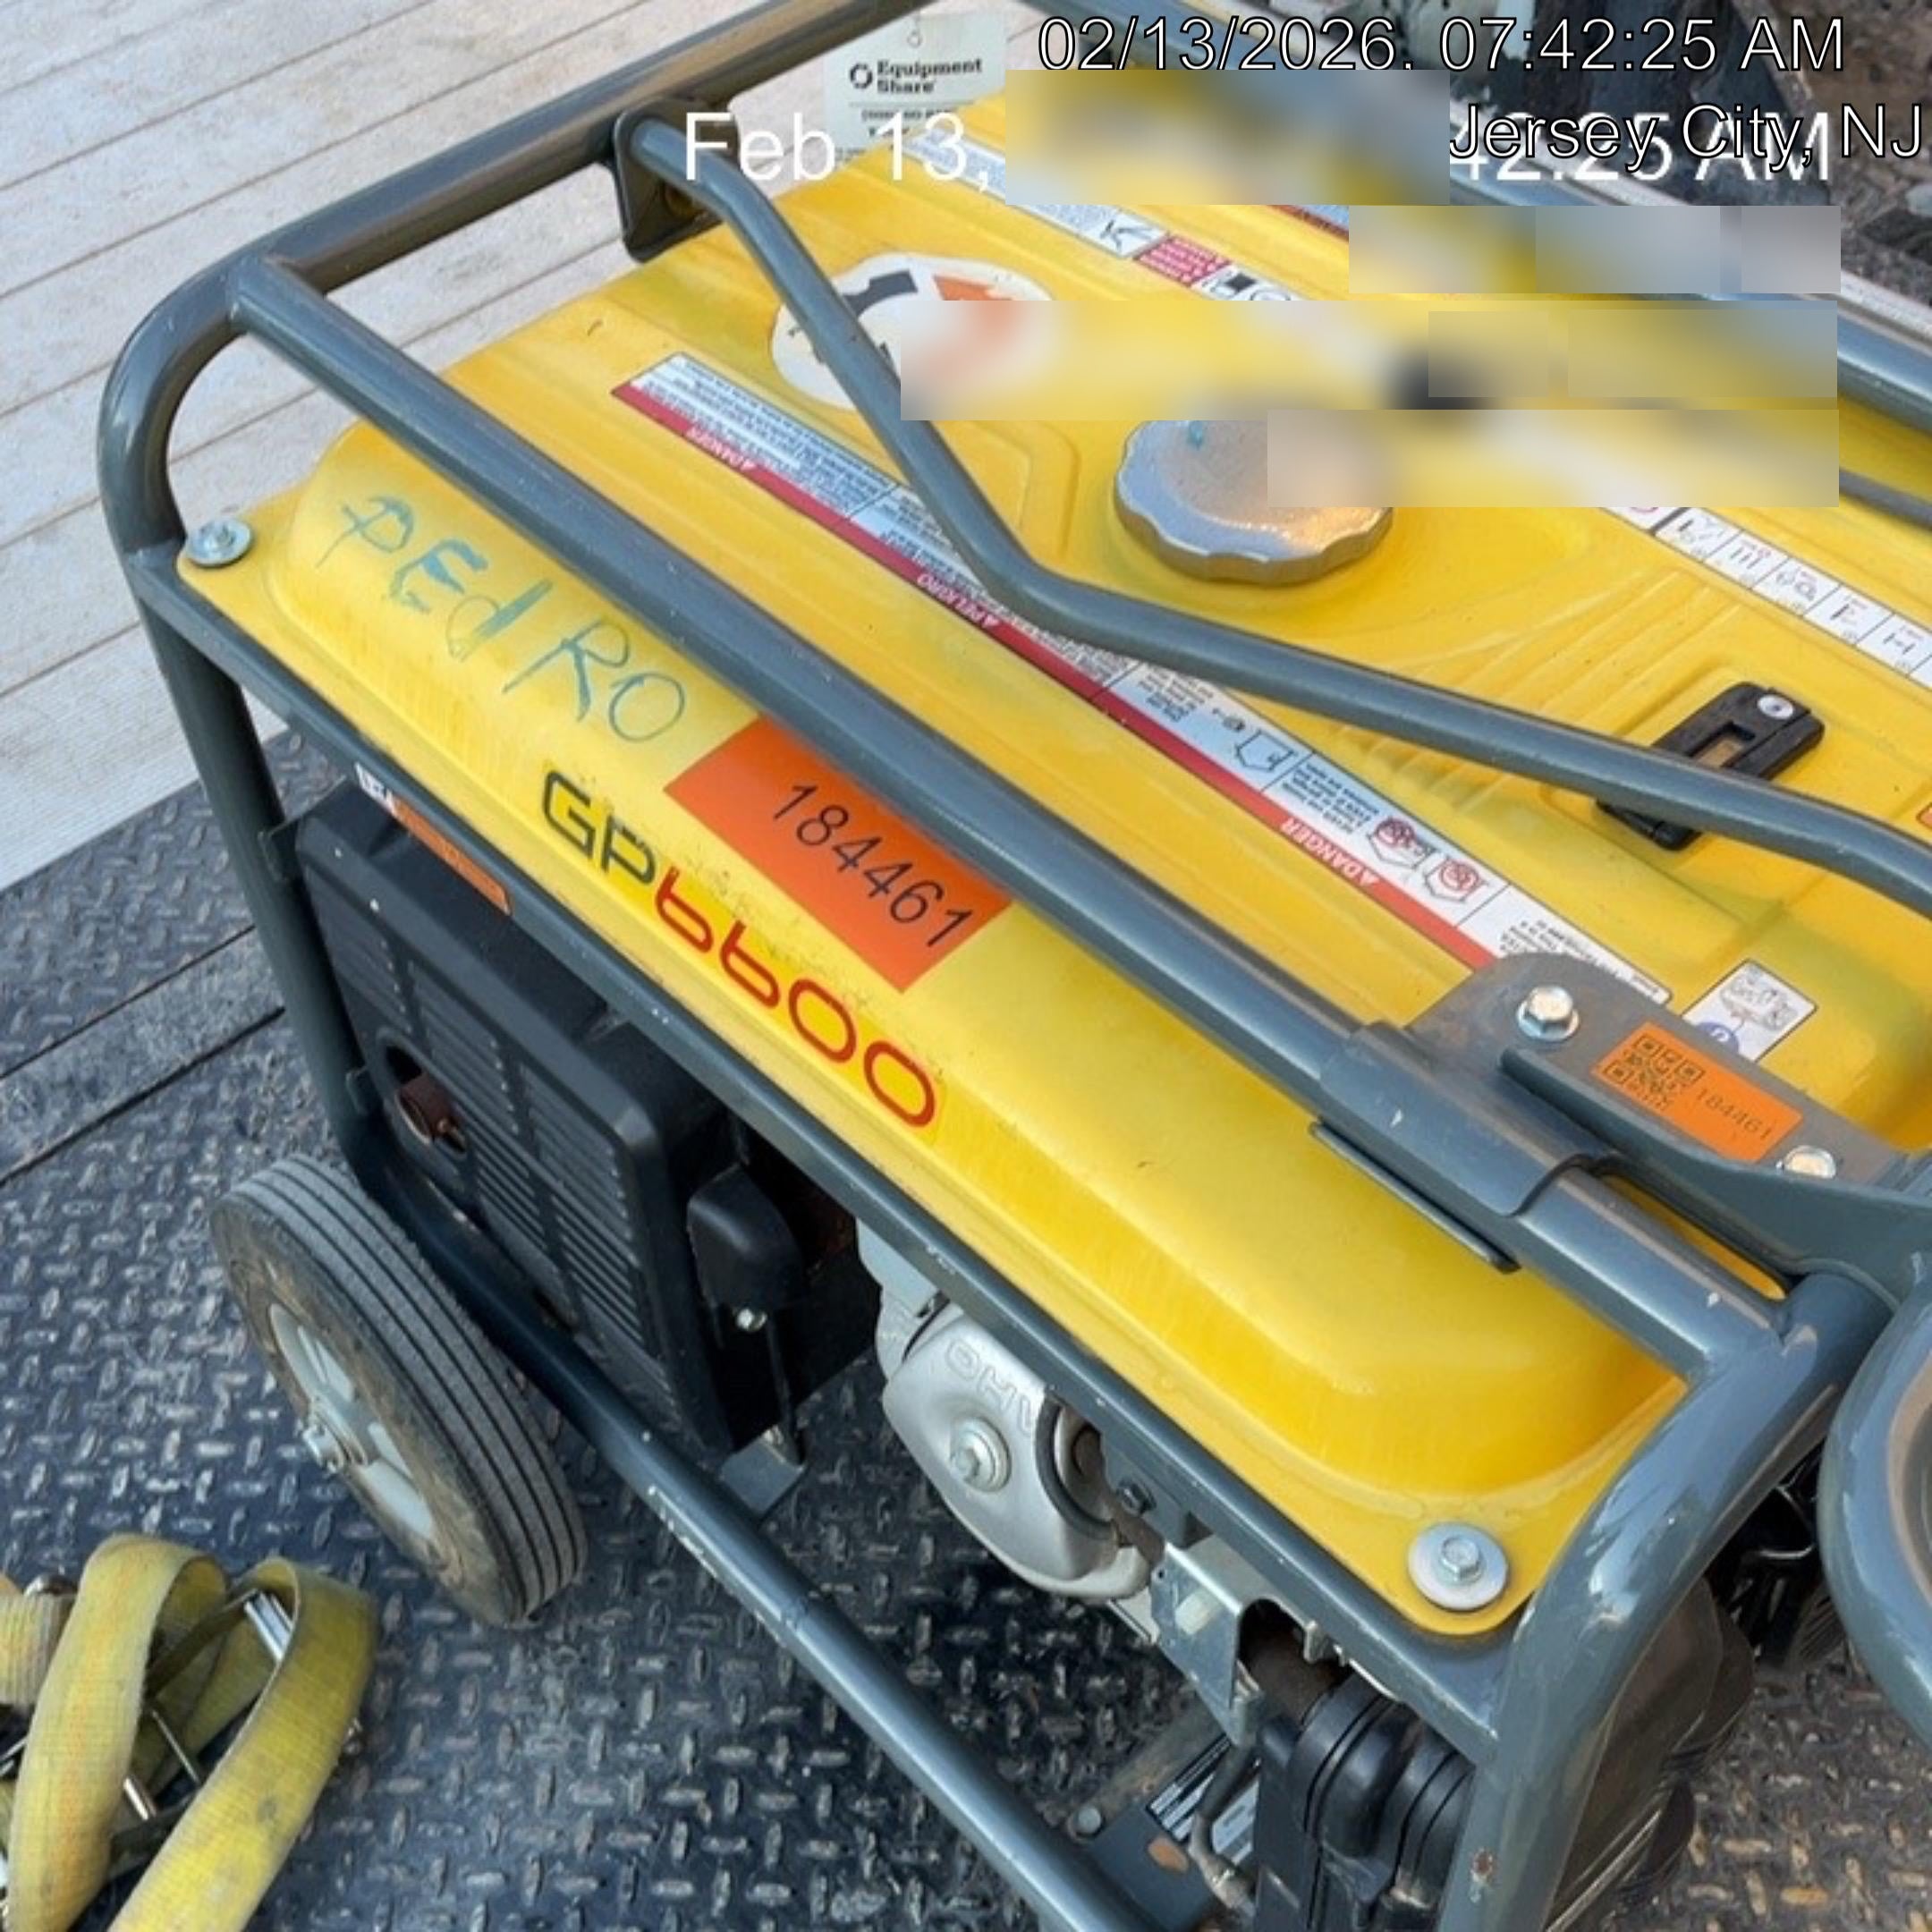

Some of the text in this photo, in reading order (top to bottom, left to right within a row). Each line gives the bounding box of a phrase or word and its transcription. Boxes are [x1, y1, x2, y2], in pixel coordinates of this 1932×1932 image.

[876, 57, 983, 80] Equipment
[876, 79, 934, 95] Share
[774, 783, 973, 949] 184461
[1279, 815, 1364, 881] DANGER
[542, 768, 936, 1130] GP6600
[1697, 1086, 1777, 1140] 184461
